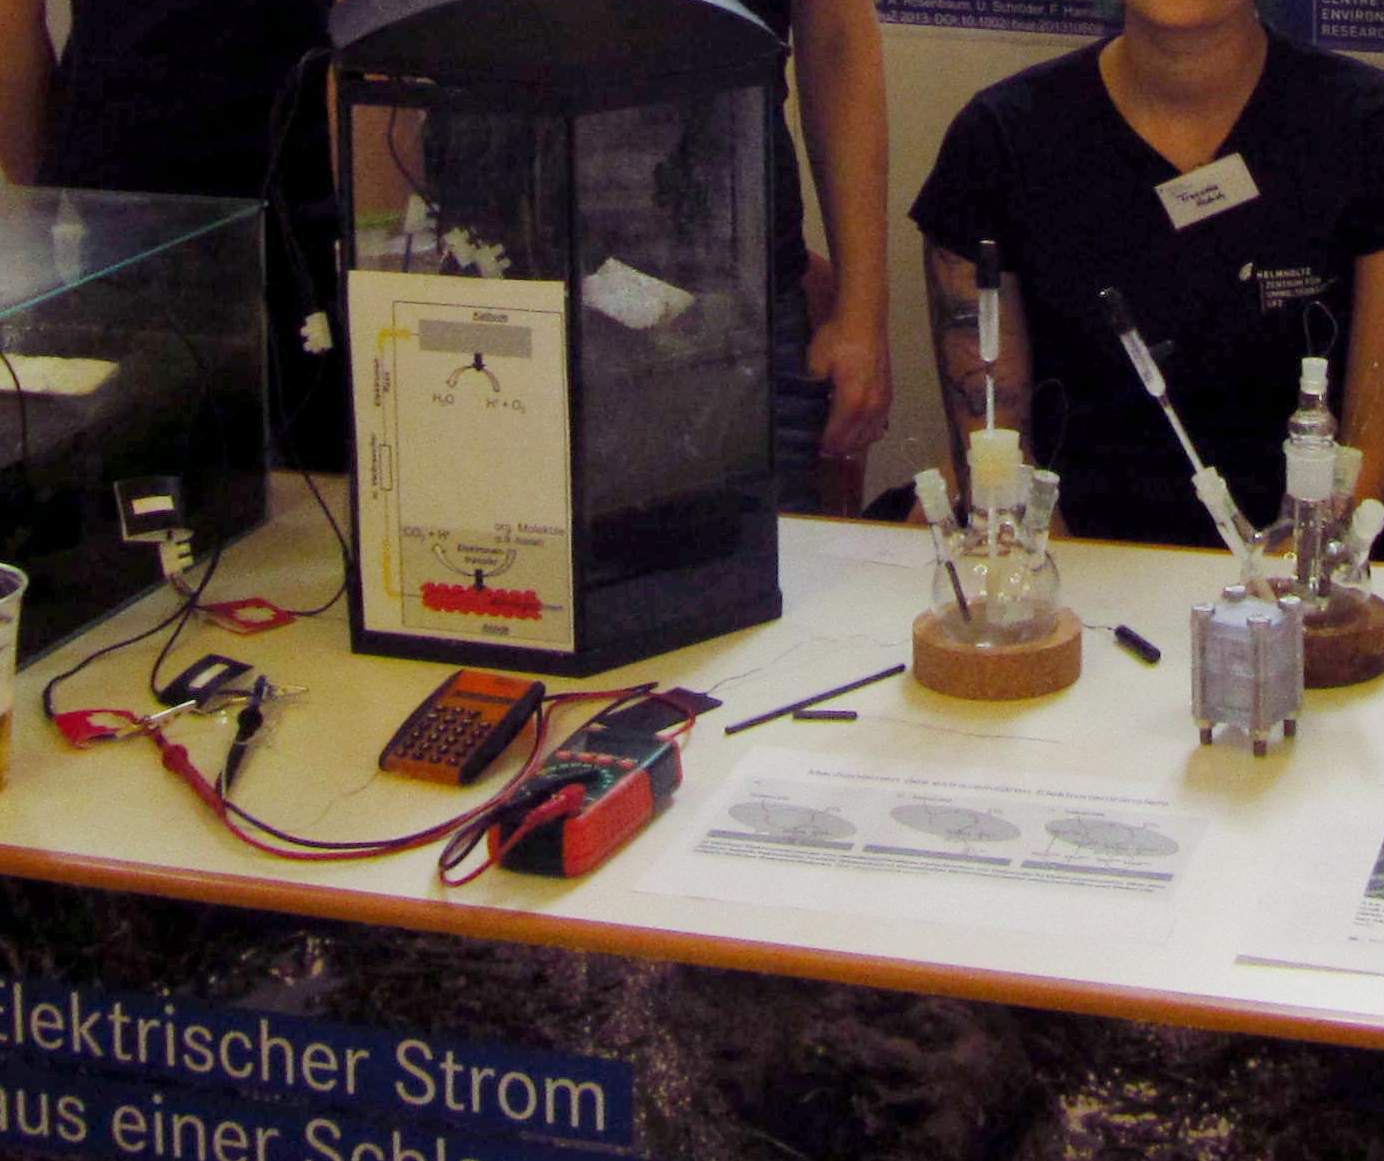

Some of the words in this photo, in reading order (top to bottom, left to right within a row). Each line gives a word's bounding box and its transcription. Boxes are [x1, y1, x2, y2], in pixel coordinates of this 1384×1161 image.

[0, 1088, 87, 1142] us
[111, 1092, 280, 1161] einer
[396, 1039, 604, 1131] Strom
